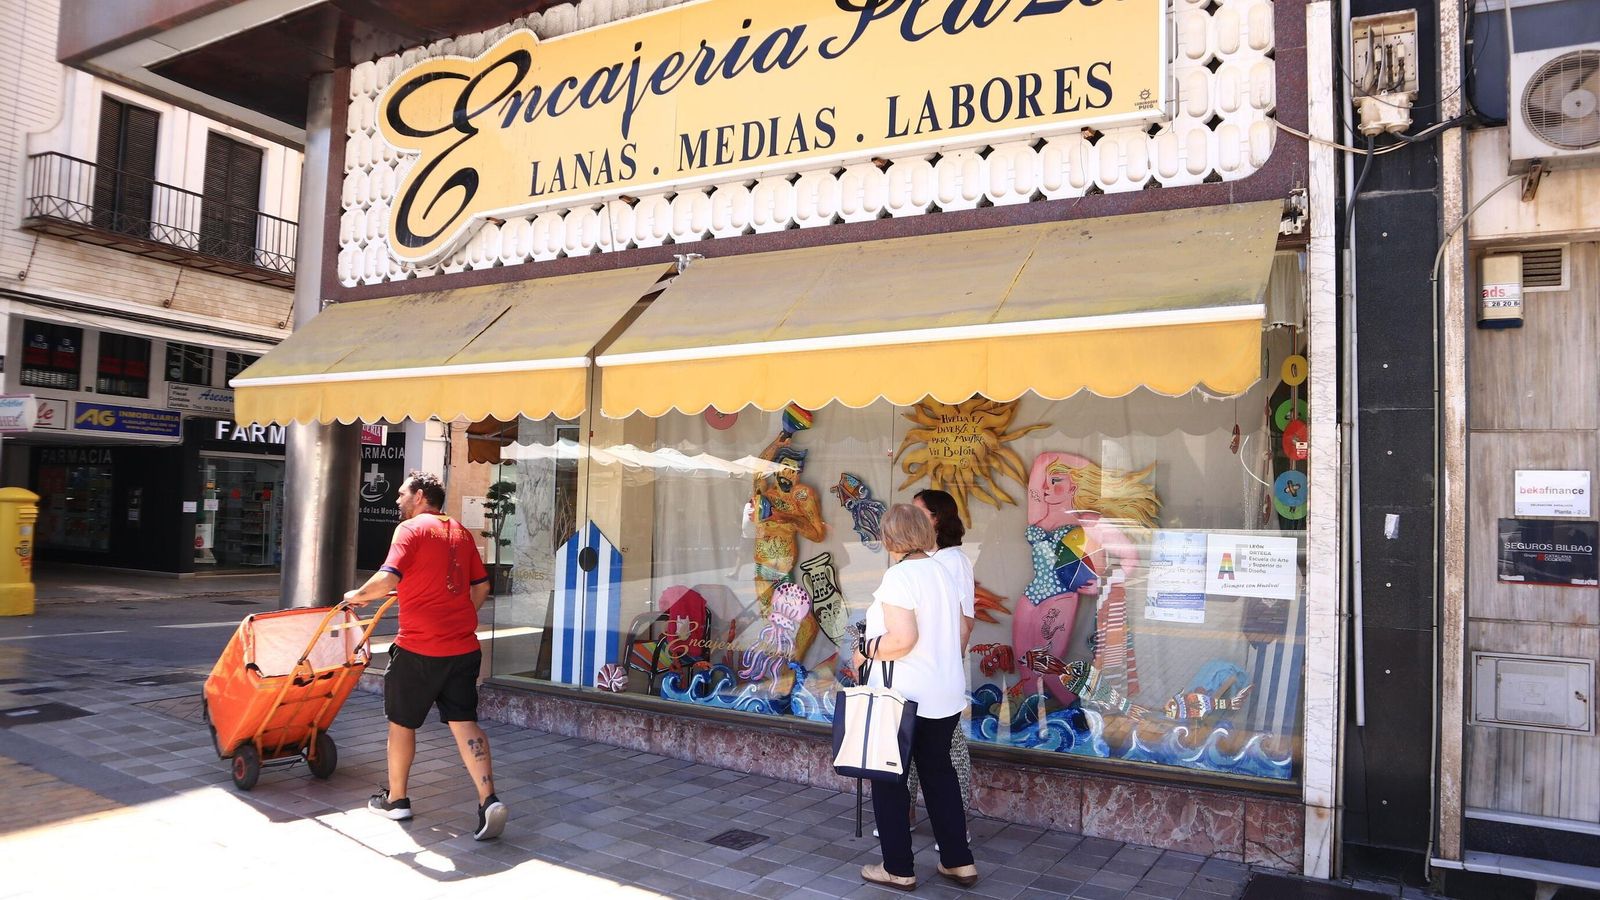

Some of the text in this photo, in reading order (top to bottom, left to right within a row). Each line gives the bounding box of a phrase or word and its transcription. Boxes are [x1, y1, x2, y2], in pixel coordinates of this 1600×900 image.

[386, 0, 1125, 248] Encajeria Pla
[529, 142, 637, 197] LANAS
[677, 107, 836, 172] MEDIAS
[885, 61, 1113, 139] LABORES
[76, 408, 116, 426] AG
[119, 411, 180, 421] INMOBILIARIA
[41, 448, 112, 464] FARMACIA
[1504, 542, 1593, 553] SEGUROS BILBAO
